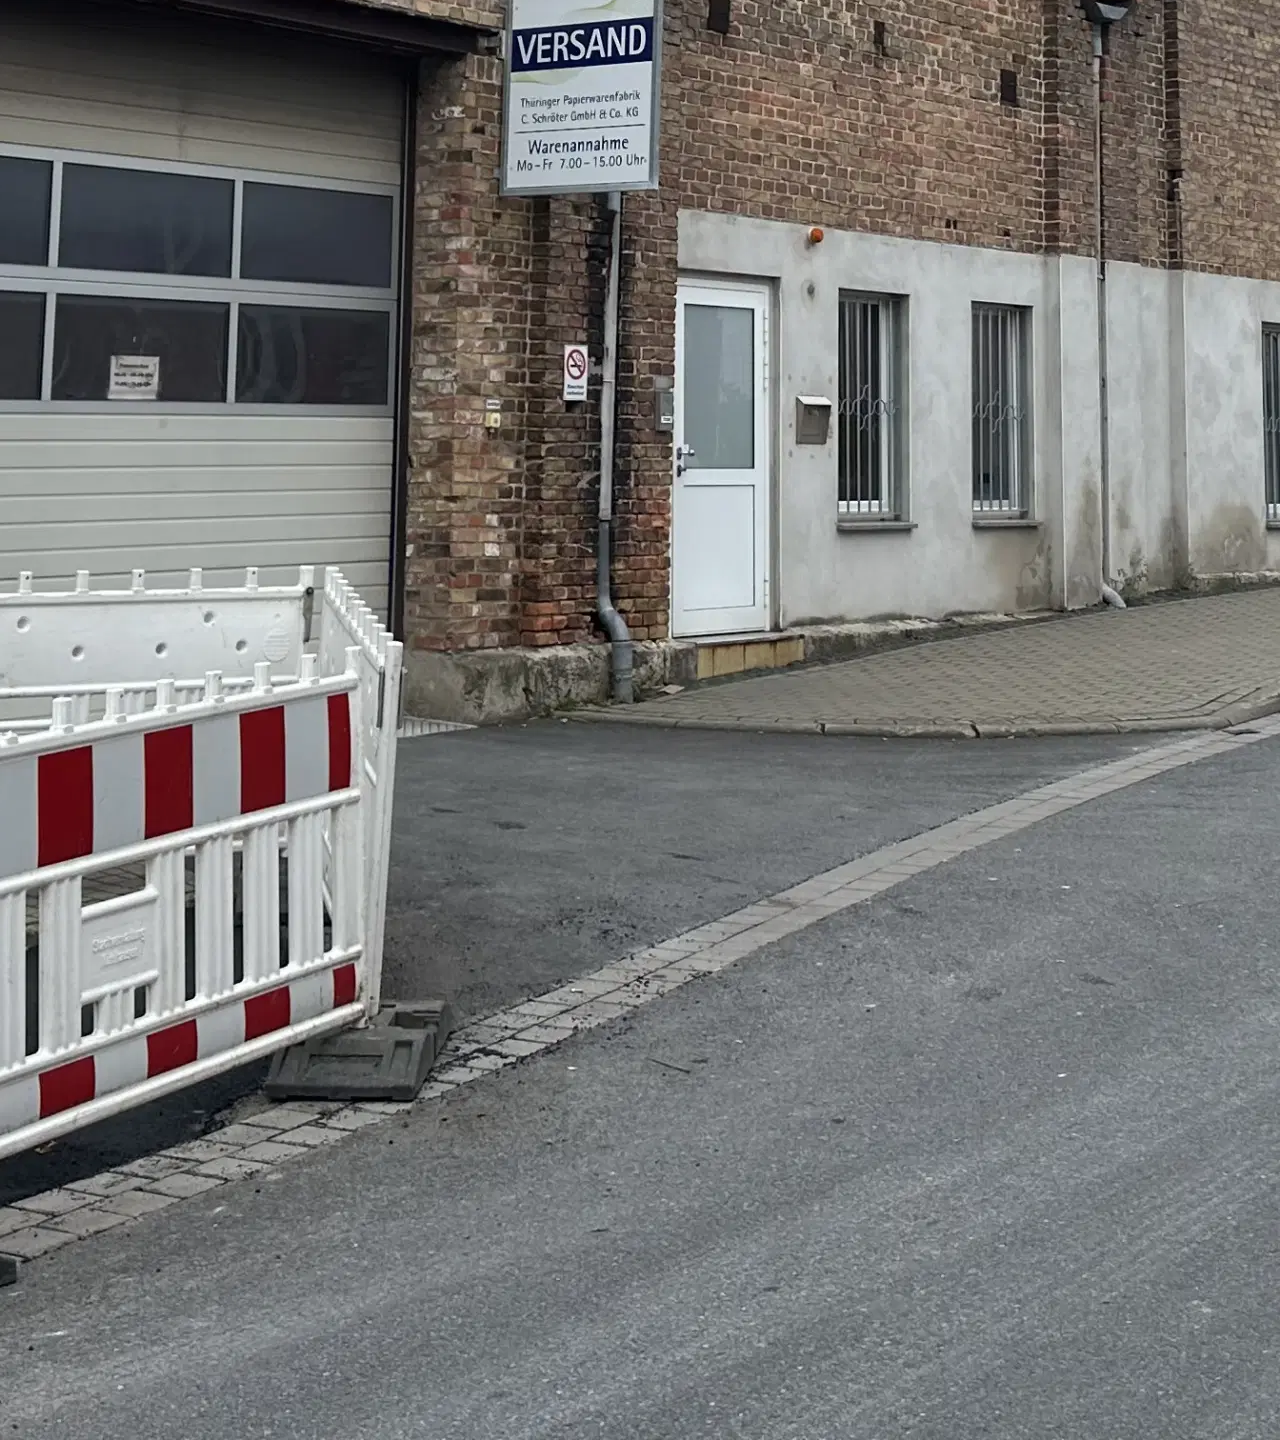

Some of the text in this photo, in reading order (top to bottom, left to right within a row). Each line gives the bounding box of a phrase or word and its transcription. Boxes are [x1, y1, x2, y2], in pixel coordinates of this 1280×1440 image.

[517, 24, 647, 64] VERSAND
[521, 90, 641, 109] Thüringer Papierwarenfabrik
[521, 106, 639, 124] C. Schröter GmbH & Co. KG
[528, 135, 629, 155] Warenannahme
[626, 154, 644, 166] Uhr
